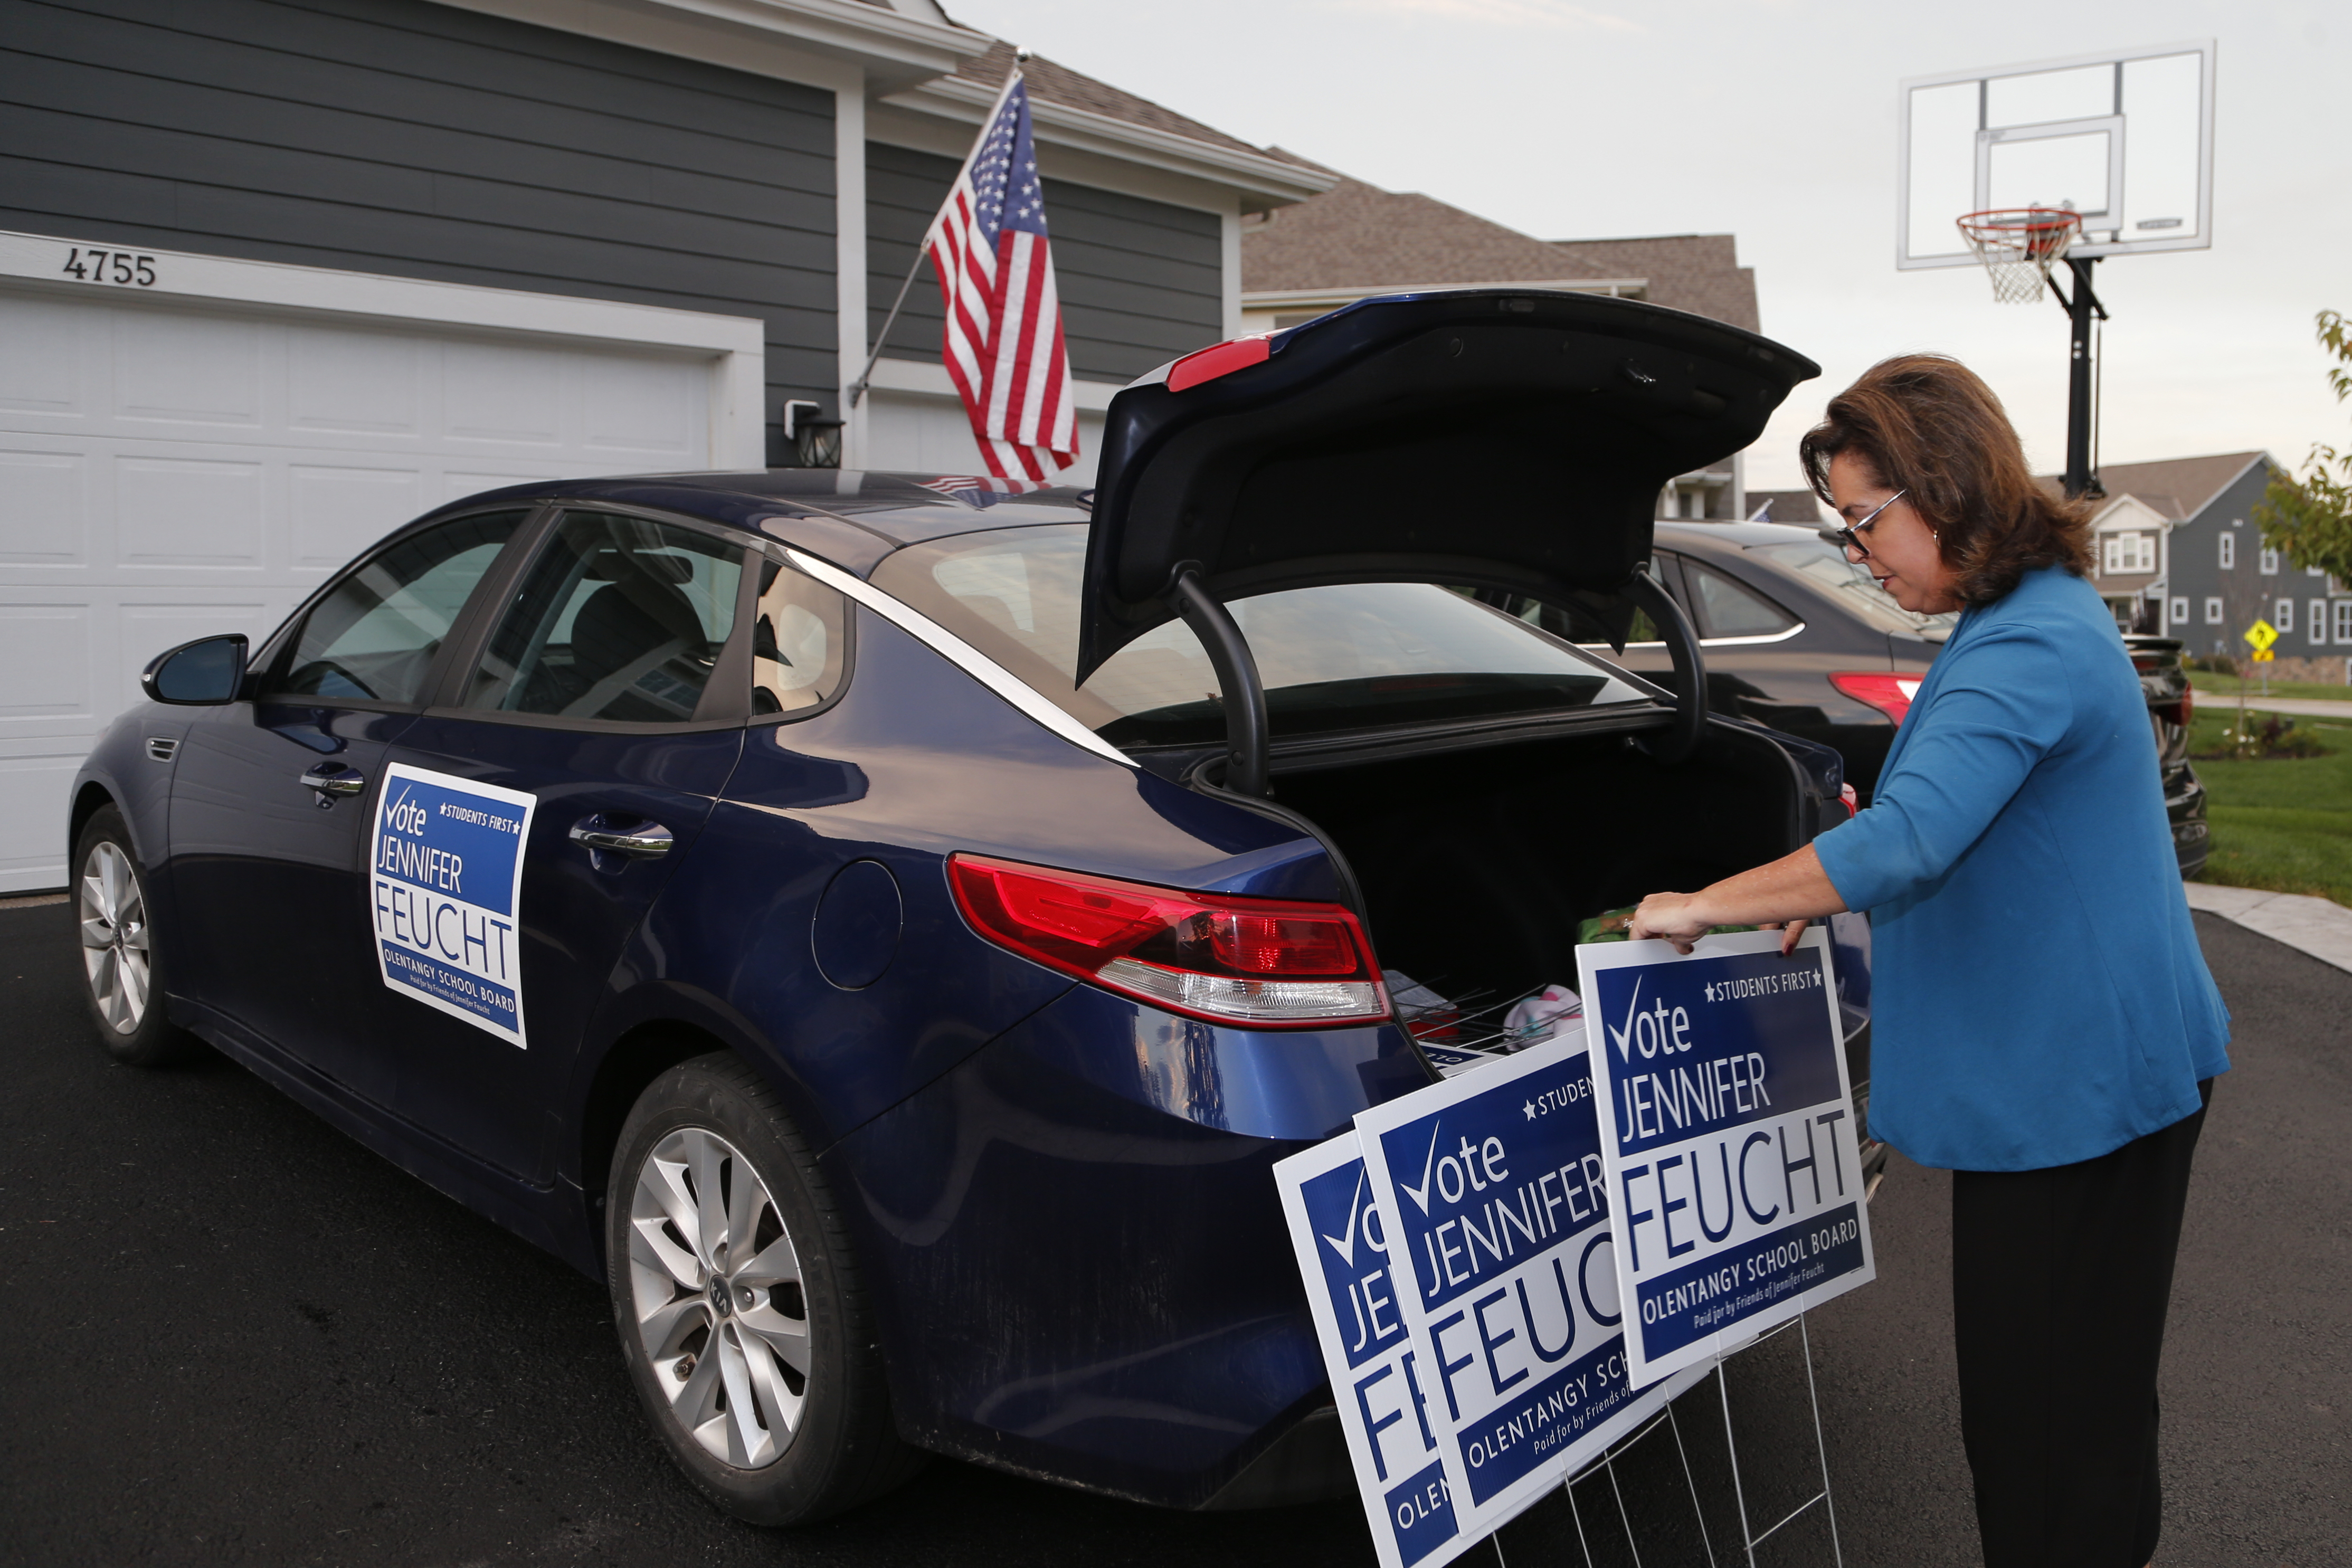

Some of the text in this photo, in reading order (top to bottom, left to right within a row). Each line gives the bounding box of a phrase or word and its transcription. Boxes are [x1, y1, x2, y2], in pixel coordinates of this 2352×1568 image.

[63, 248, 156, 286] 4755
[447, 804, 514, 833] STUDENTS FIRST
[378, 834, 462, 894] JENNIFER
[376, 880, 512, 980] FEUCHT
[385, 949, 515, 1013] OLENTANGY SCHOOL BOARD
[410, 974, 420, 985] Paid
[427, 981, 433, 991] by
[433, 984, 449, 997] Friends
[450, 991, 455, 1001] of
[456, 994, 474, 1008] Jennifer
[475, 1001, 490, 1014] Feucht
[1716, 971, 1810, 1002] STUDENTS FIRST
[1538, 1077, 1594, 1115] STUDEN
[1622, 1052, 1771, 1143] JENNIFER
[1621, 1109, 1845, 1273] FEUCHT
[1424, 1153, 1609, 1297] JENNIFER
[710, 1281, 727, 1313] KIA
[1643, 1219, 1857, 1324] OLENTANGY SCHOOL BOARD
[1694, 1262, 1825, 1328] Paid for by Friends of Jennifer Feucht
[1428, 1231, 1623, 1423] FEUC
[1469, 1374, 1588, 1468] OLENTANGY
[1534, 1380, 1630, 1455] Paid for by Friends of
